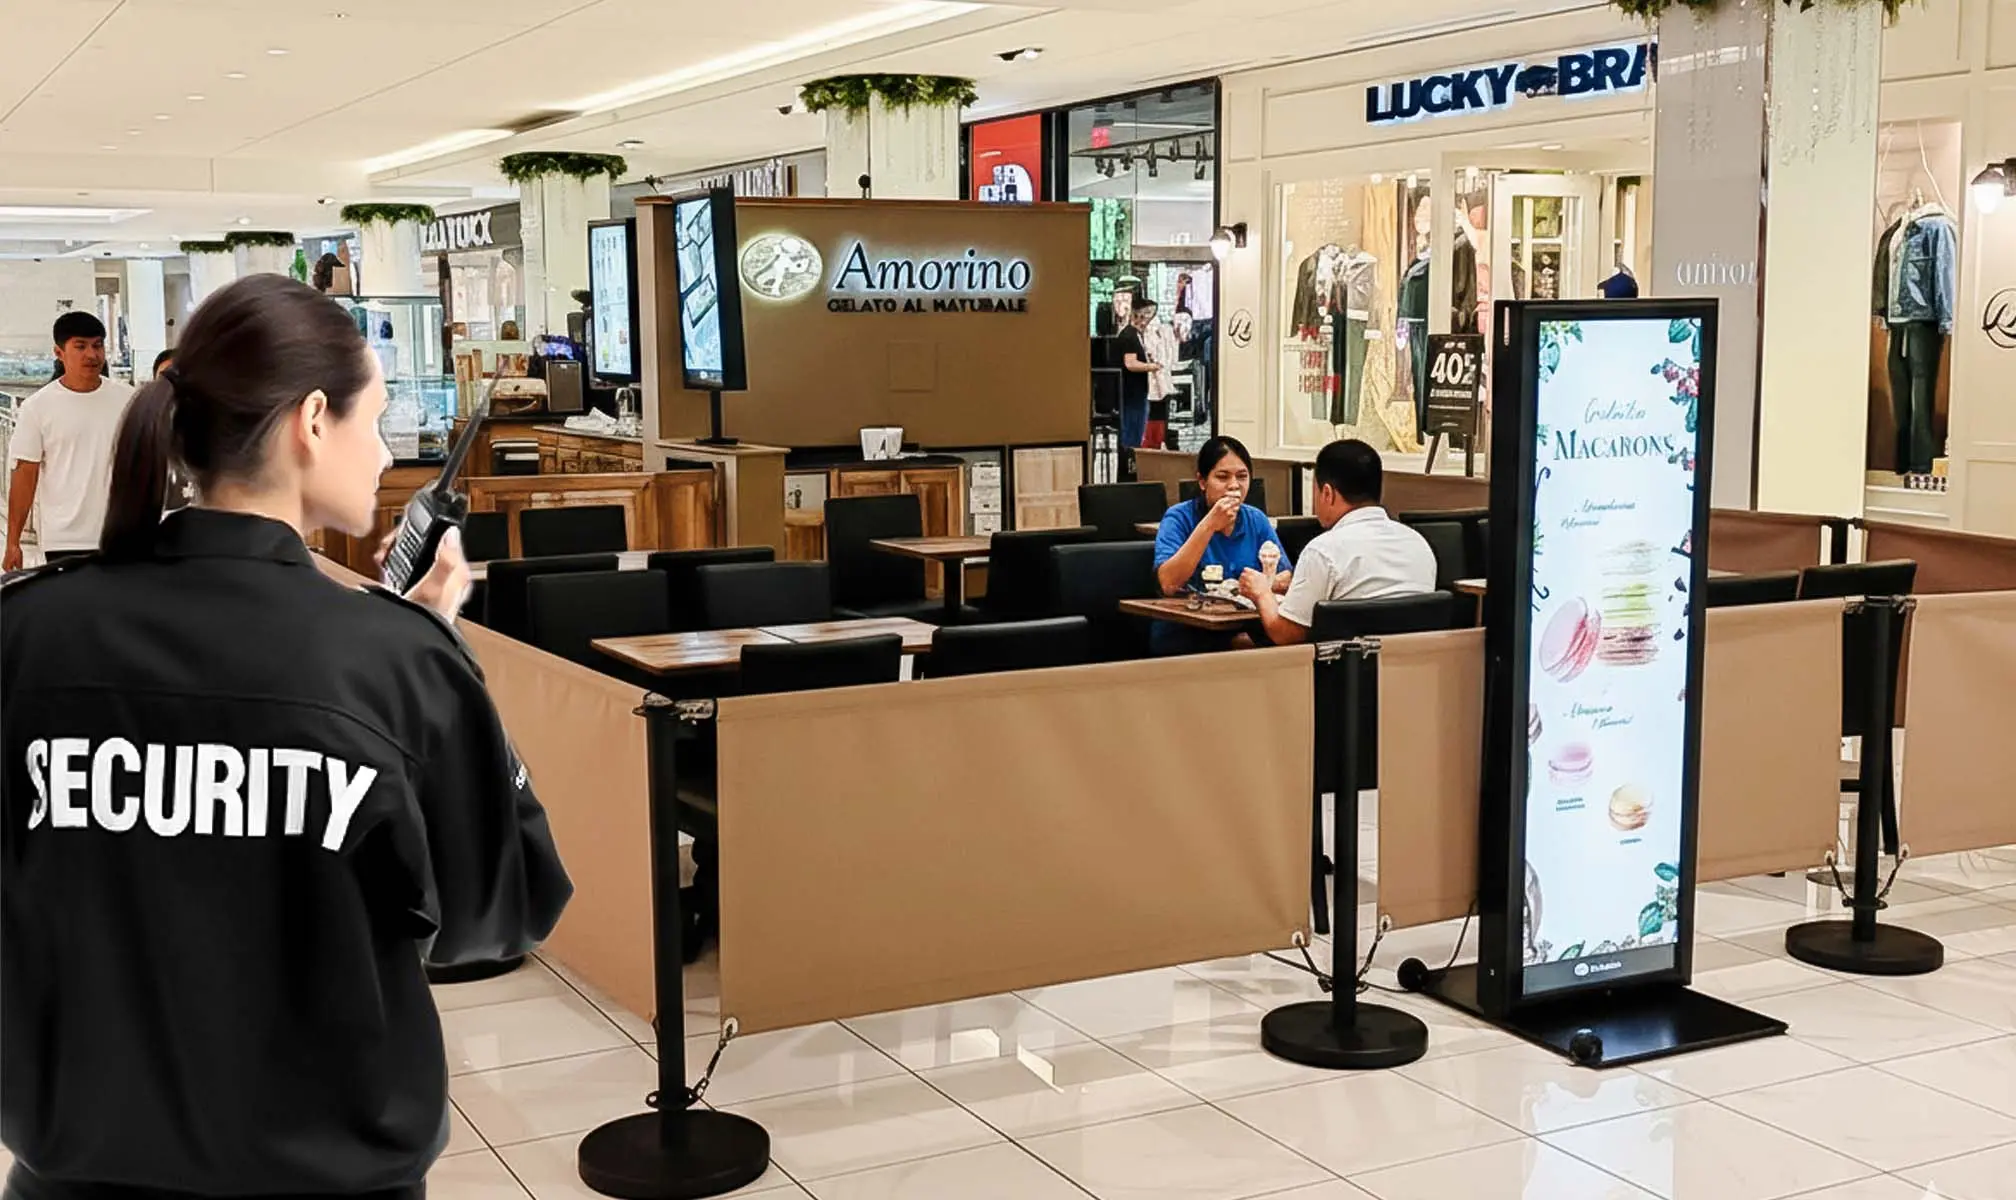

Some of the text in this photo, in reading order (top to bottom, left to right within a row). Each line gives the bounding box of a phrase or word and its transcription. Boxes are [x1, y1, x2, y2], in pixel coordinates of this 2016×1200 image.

[1366, 63, 1518, 122] LUCKY
[834, 242, 1032, 290] Amorino
[827, 299, 897, 313] GELATO
[903, 299, 926, 313] AL
[26, 737, 377, 851] SECURITY
